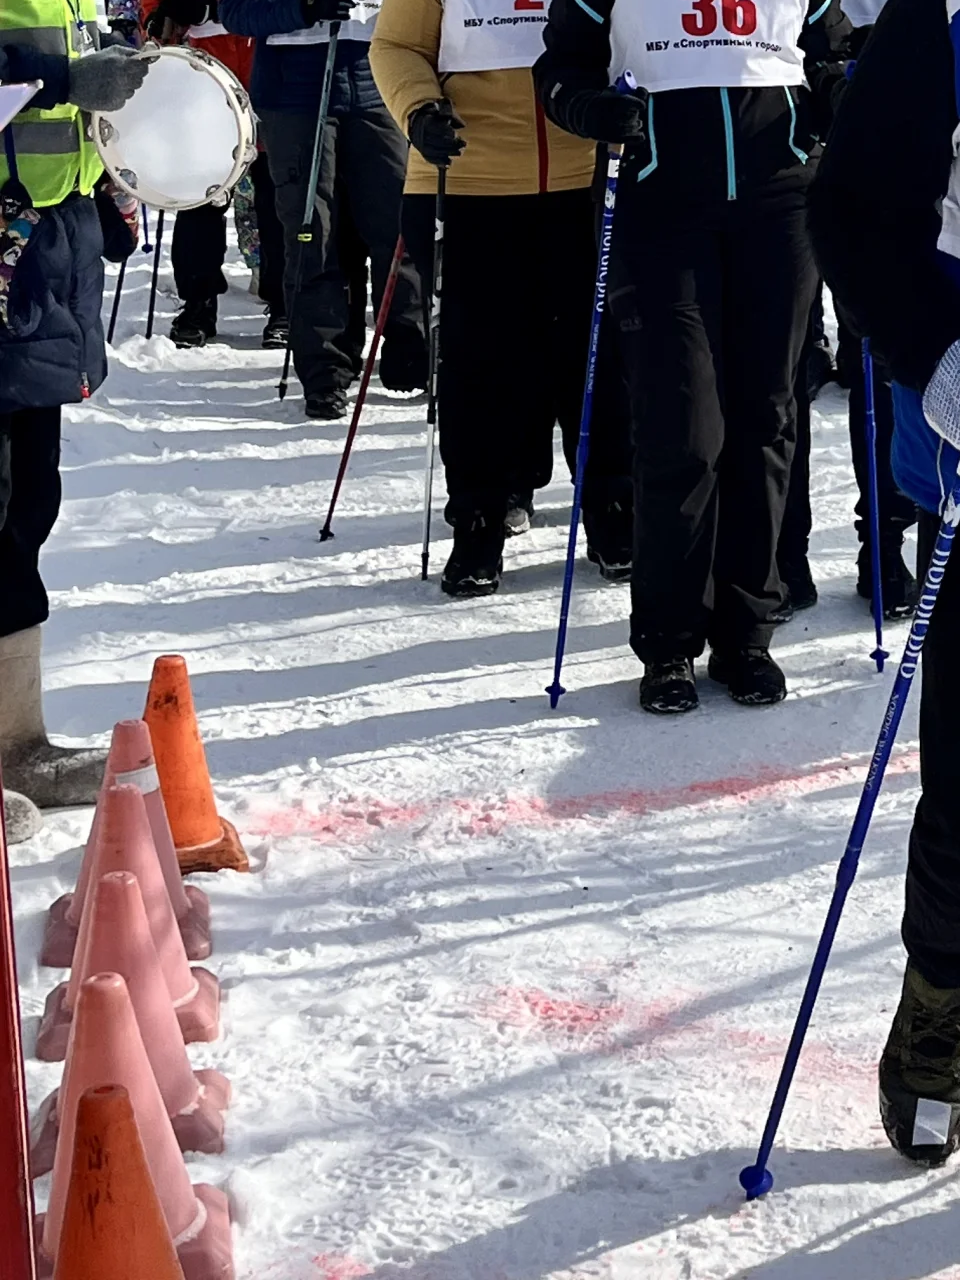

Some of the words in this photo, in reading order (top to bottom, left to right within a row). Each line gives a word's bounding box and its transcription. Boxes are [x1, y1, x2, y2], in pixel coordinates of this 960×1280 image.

[464, 18, 484, 28] МБУ
[645, 40, 670, 52] МБУ
[673, 38, 752, 51] «Спортивный
